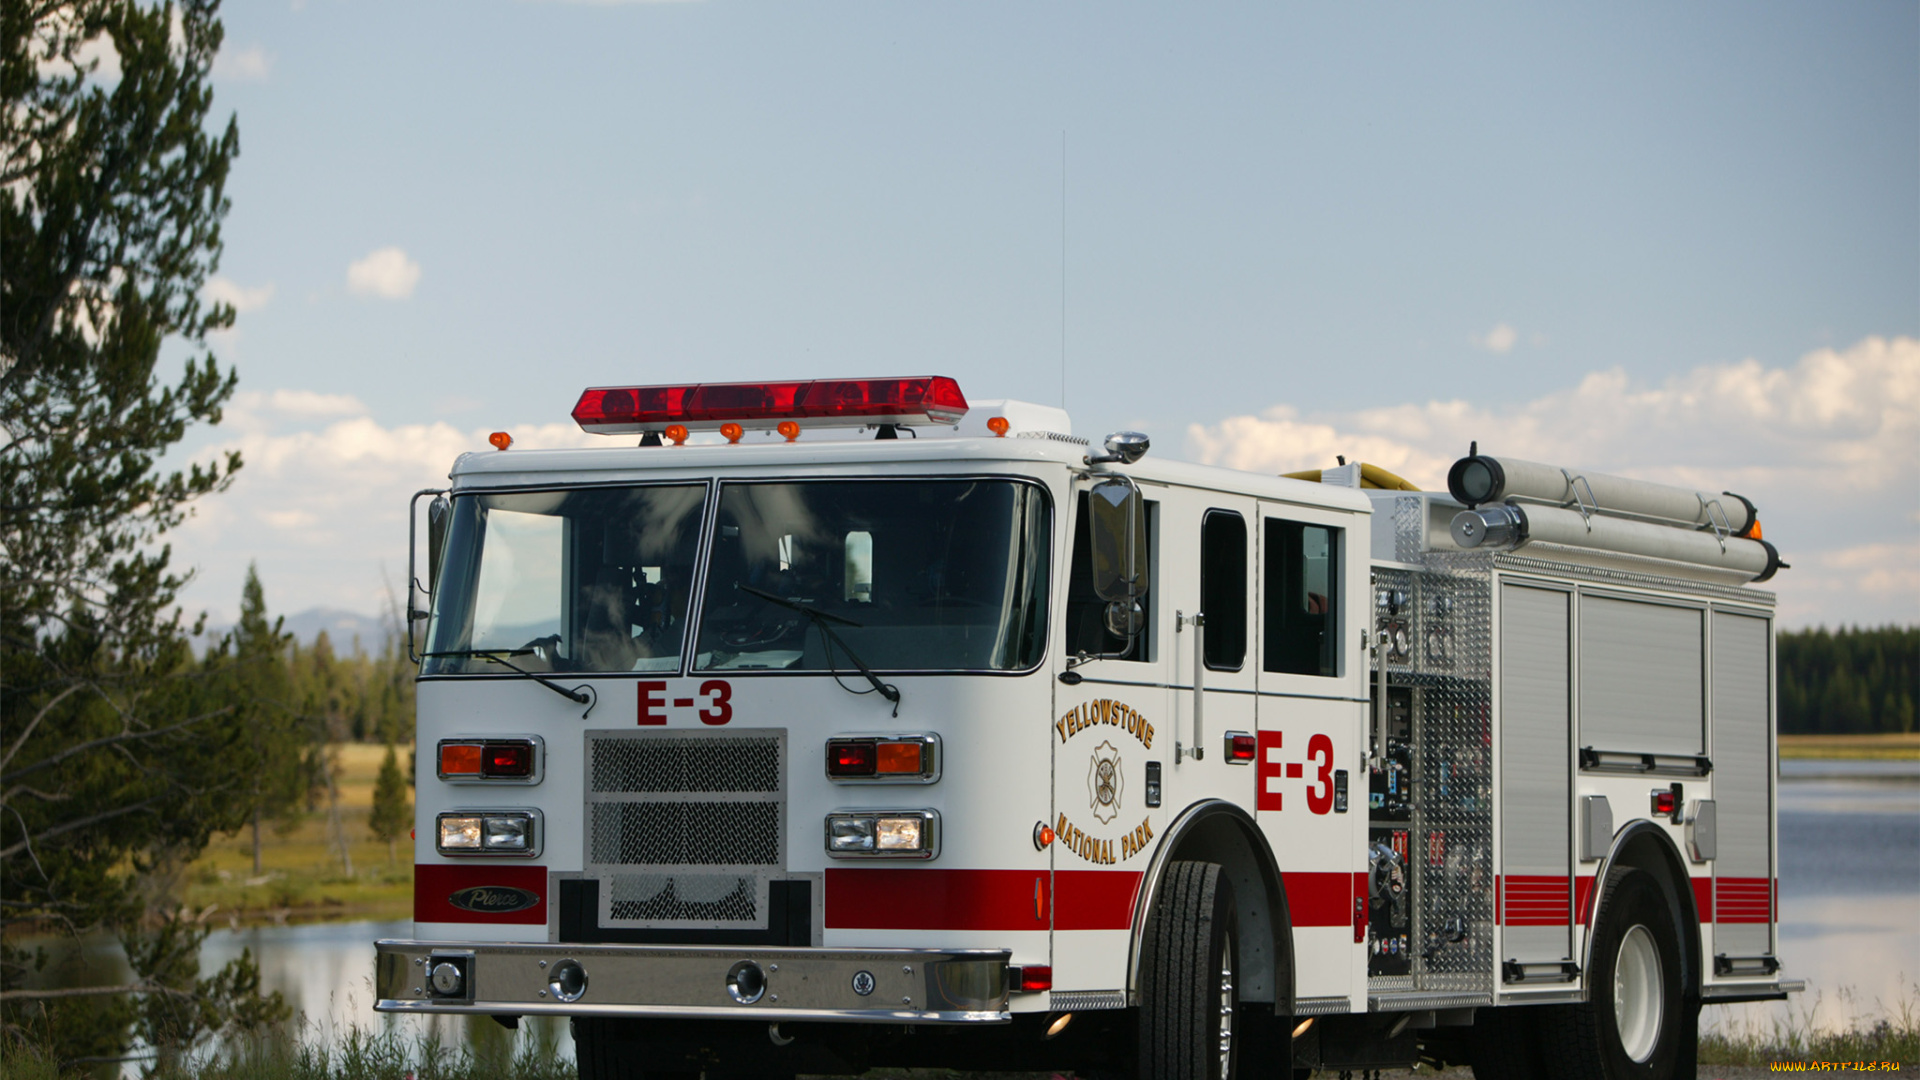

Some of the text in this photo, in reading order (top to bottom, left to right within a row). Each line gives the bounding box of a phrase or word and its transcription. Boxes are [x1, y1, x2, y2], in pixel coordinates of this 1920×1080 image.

[637, 679, 733, 726] E-3
[1056, 699, 1155, 750] YELLOWSTONE
[1257, 730, 1334, 815] E-3
[1055, 812, 1154, 865] NATIONAL PARK
[468, 889, 518, 908] Pierce
